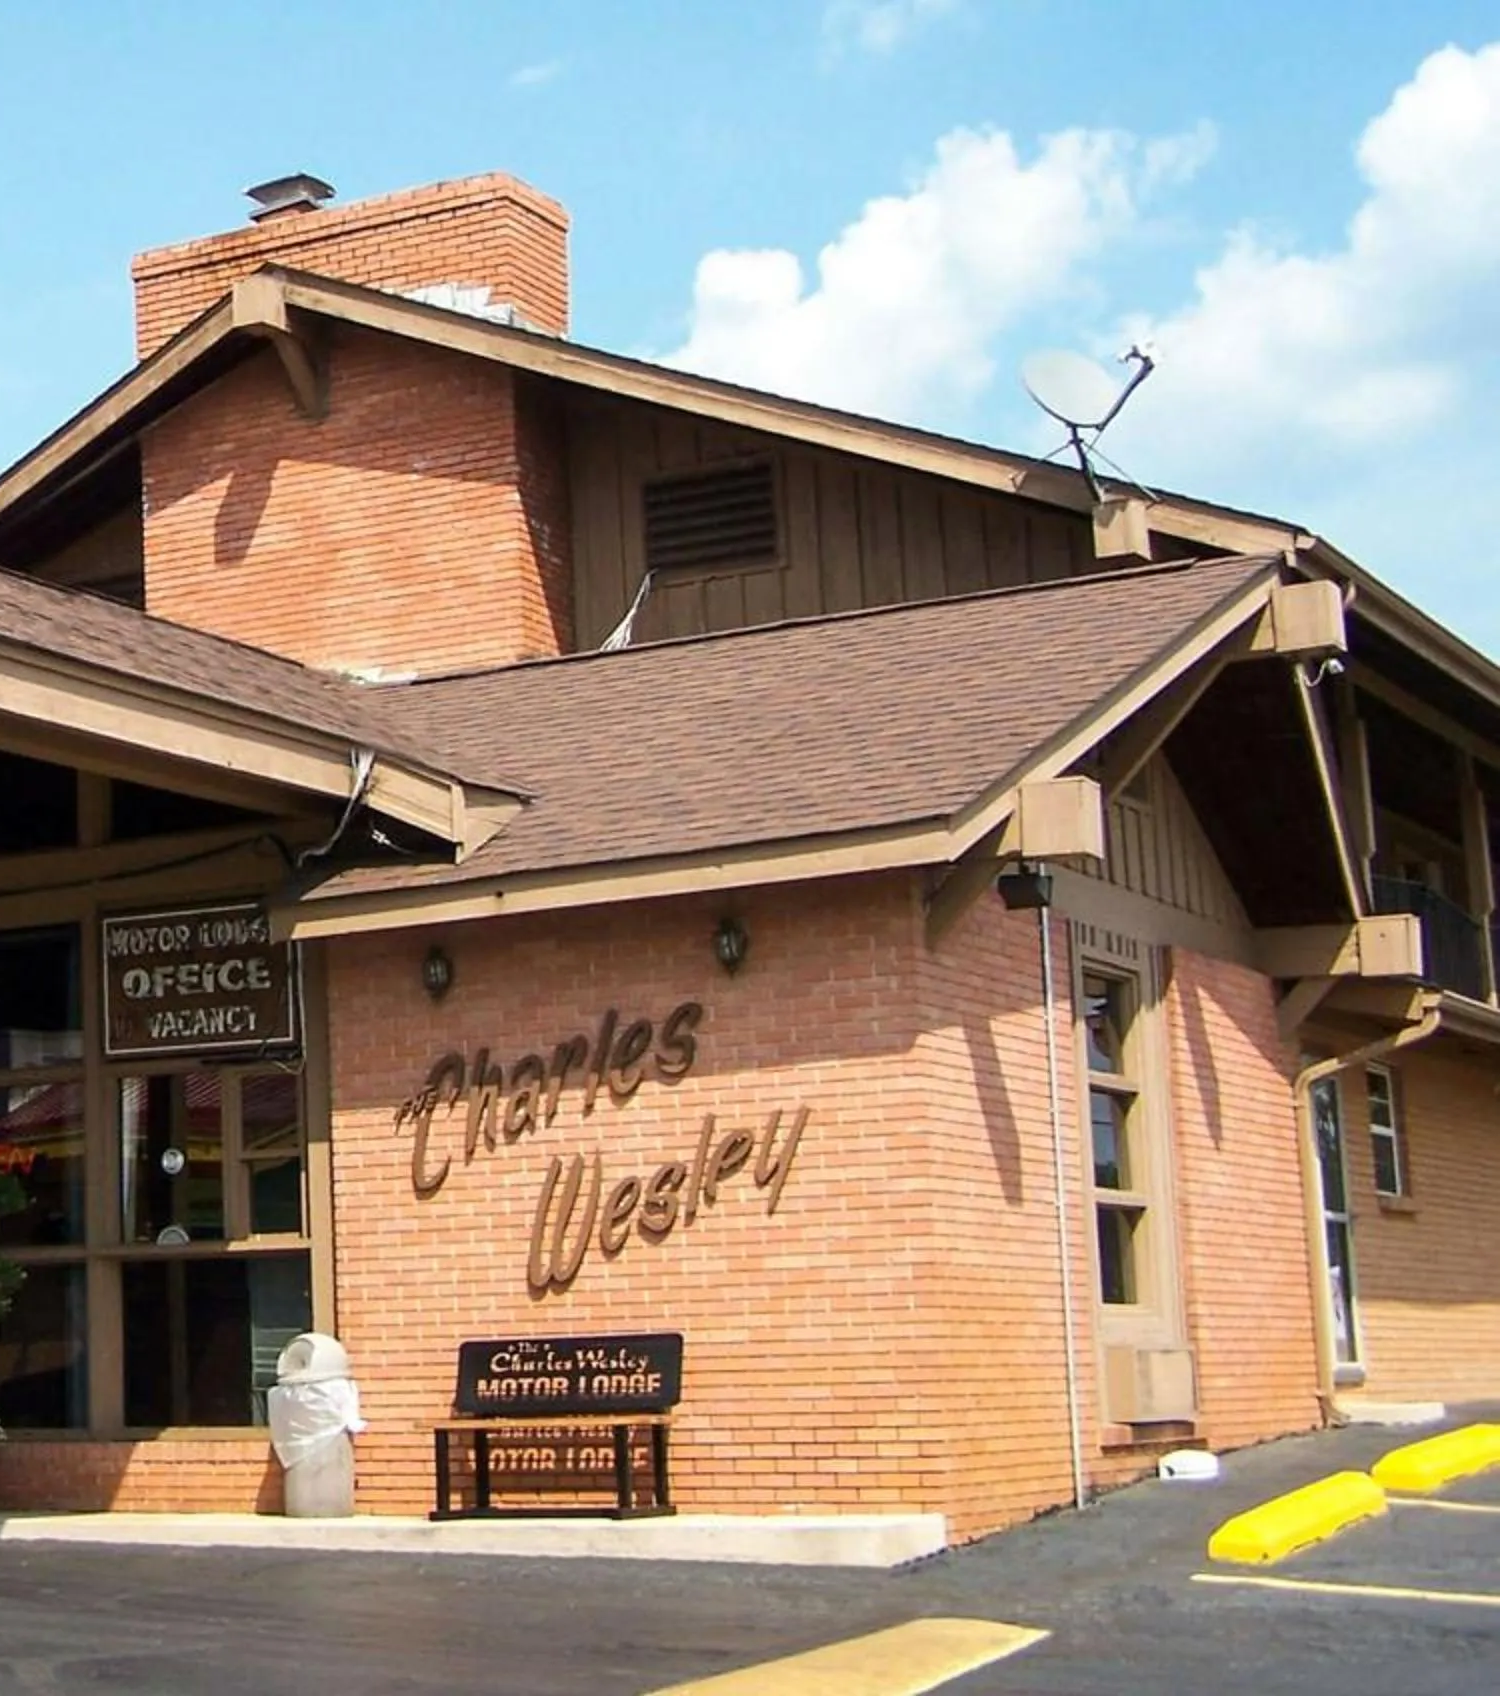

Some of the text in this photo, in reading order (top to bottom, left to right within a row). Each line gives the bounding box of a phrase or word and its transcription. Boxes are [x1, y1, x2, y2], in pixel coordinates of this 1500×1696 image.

[108, 917, 267, 957] MOTOR LODG
[122, 958, 272, 999] OFFICE
[150, 1006, 256, 1039] VACANCY
[412, 1002, 704, 1196] Charles
[527, 1104, 812, 1293] Wesley
[490, 1348, 649, 1374] Charles Wesley
[477, 1373, 662, 1400] MOTOR LODGE
[566, 1447, 649, 1469] LODE
